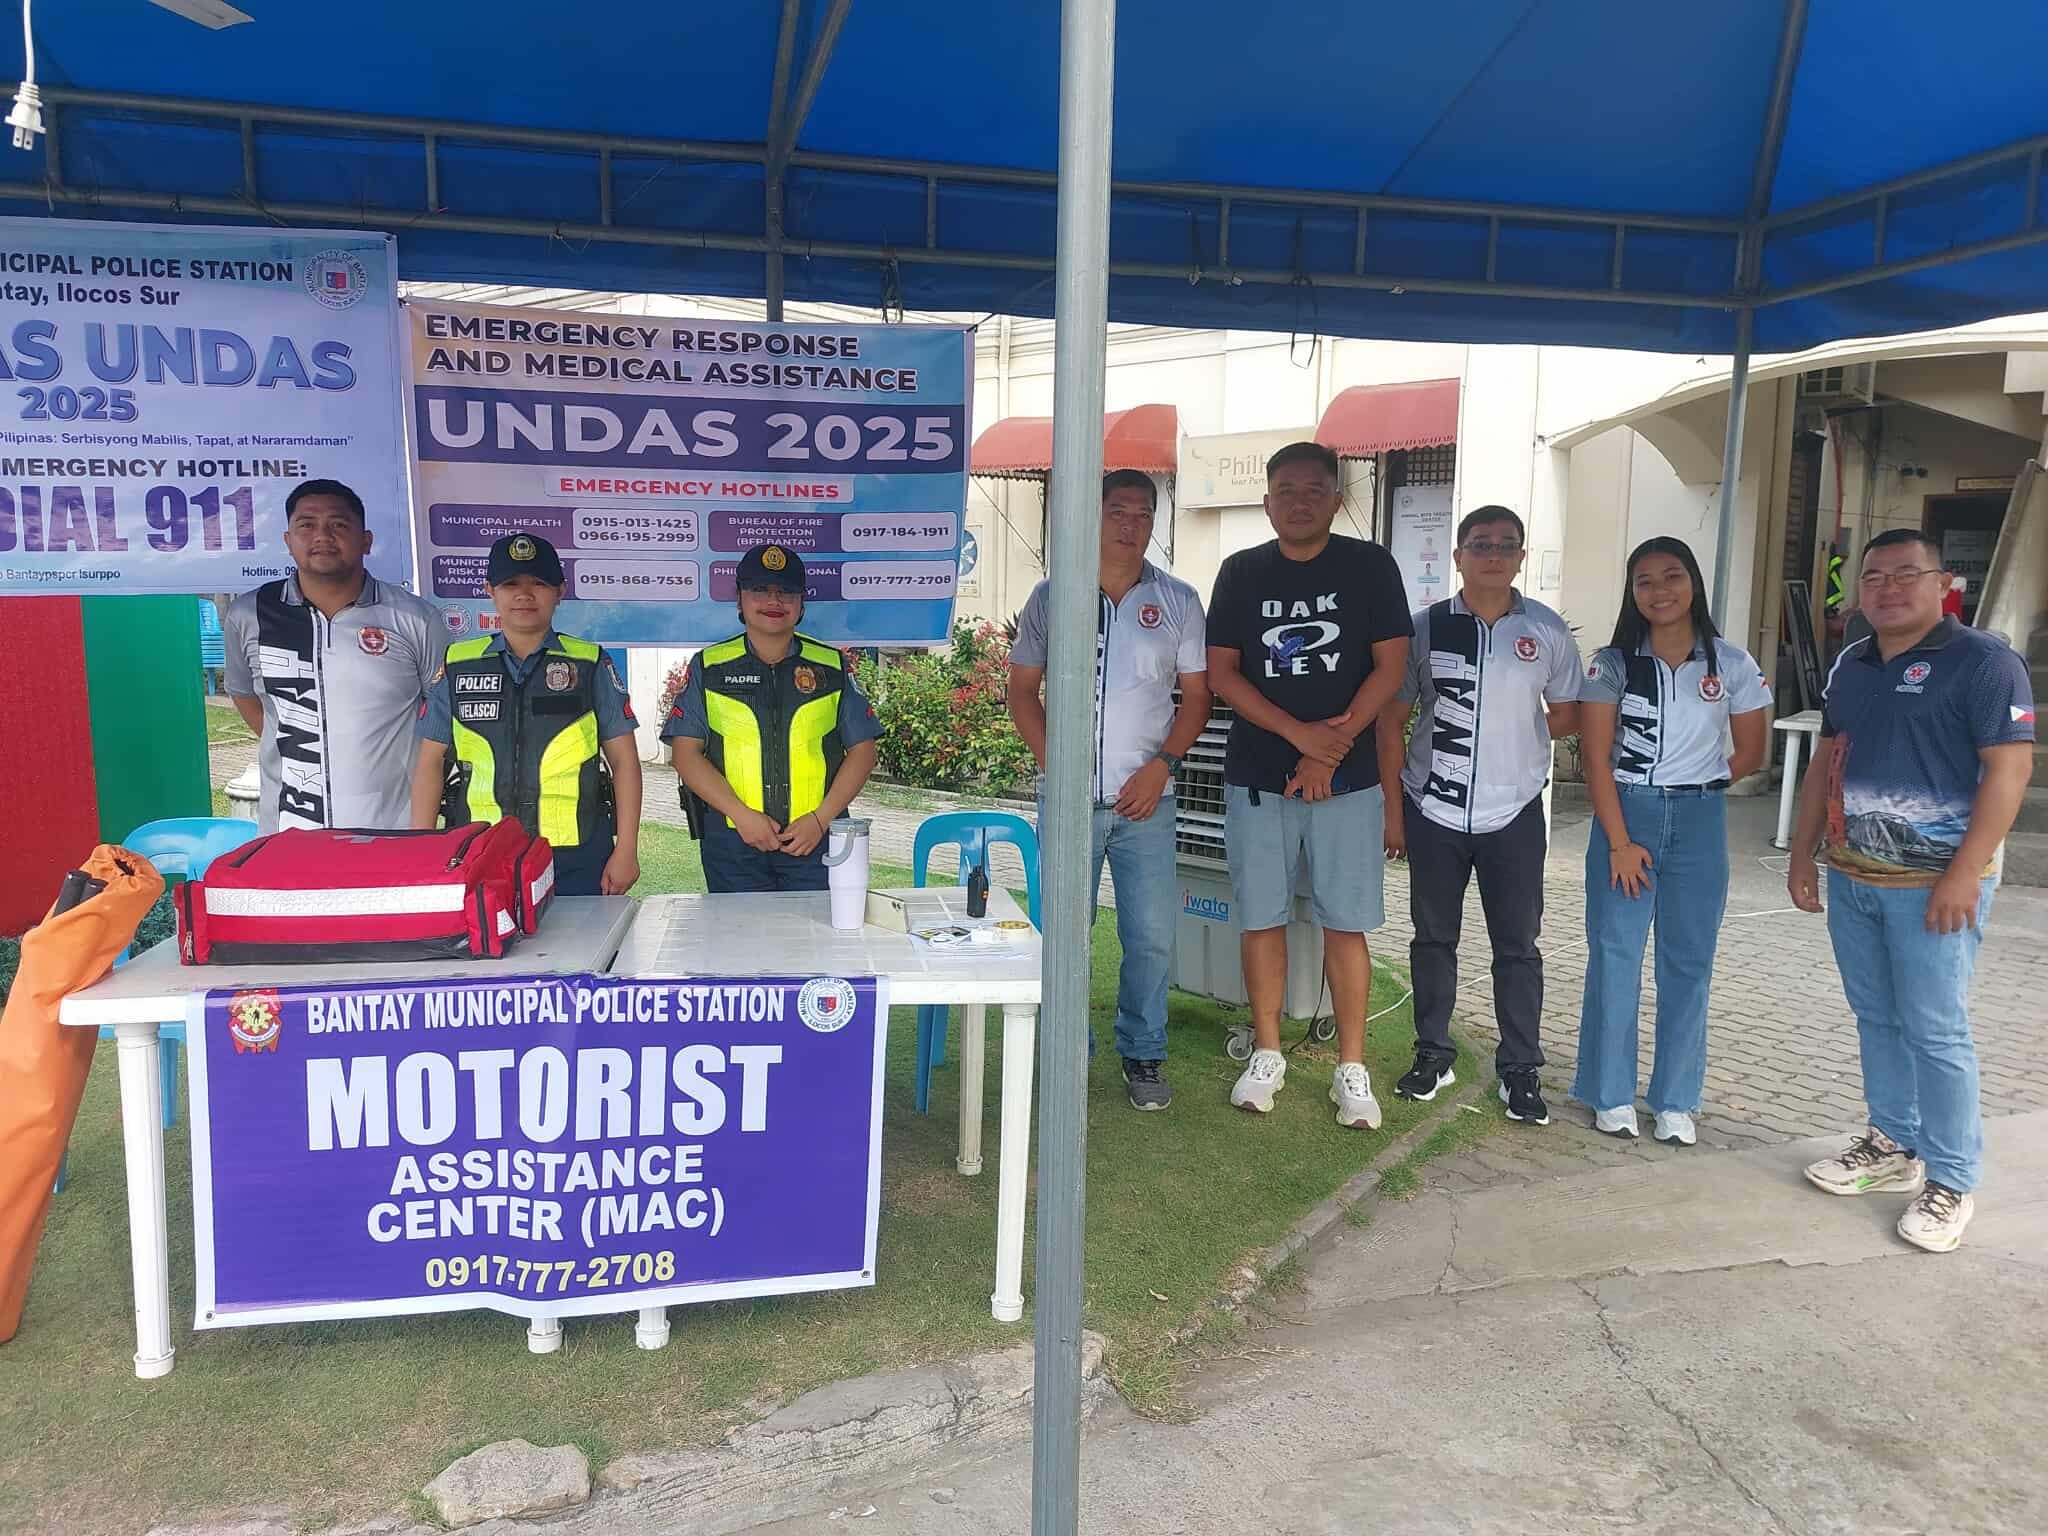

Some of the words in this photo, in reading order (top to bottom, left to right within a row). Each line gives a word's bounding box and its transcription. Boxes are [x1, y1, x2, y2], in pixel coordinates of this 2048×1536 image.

[91, 255, 182, 279] POLICE
[190, 260, 293, 282] STATION
[58, 282, 132, 304] Ilocos
[140, 285, 180, 306] Sur
[426, 314, 660, 349] EMERGENCY
[672, 329, 859, 359] RESPONSE
[84, 322, 357, 392] UNDAS
[426, 348, 512, 374] AND
[524, 352, 692, 384] MEDICAL
[703, 361, 917, 392] ASSISTANCE
[17, 385, 139, 422] 2025
[62, 432, 138, 447] Serbisyong
[142, 434, 192, 447] Mabilis,
[196, 434, 234, 448] Tapat,
[237, 436, 249, 446] at
[428, 398, 740, 458] UNDAS
[766, 411, 955, 463] 2025
[177, 459, 307, 478] HOTLINE:
[560, 477, 713, 497] EMERGENCY
[722, 481, 840, 499] HOTLINES
[145, 486, 256, 552] 911
[441, 516, 510, 526] MUNICIPAL
[513, 518, 562, 527] HEALTH
[582, 516, 692, 529] 0915-013-1425
[728, 517, 777, 526] BUREAU
[798, 518, 824, 526] FIRE
[579, 531, 696, 543] 0966-195-2999
[739, 527, 813, 537] PROTECTION
[852, 526, 950, 538] 0917-184-1911
[242, 566, 282, 577] Hotline:
[439, 558, 490, 567] MUNICIP
[448, 568, 475, 576] RISK
[579, 574, 694, 586] 0915-868-7536
[849, 574, 952, 586] 0917-777-2708
[1262, 592, 1338, 618] OAK
[1265, 652, 1341, 678] LEY
[458, 675, 499, 691] POLICE
[724, 675, 761, 684] PADRE
[460, 702, 497, 719] VELASCO
[307, 993, 416, 1034] BANTAY
[424, 987, 569, 1029] MUNICIPAL
[575, 987, 669, 1024] POLICE
[676, 987, 785, 1023] STATION
[305, 1045, 783, 1151] MOTORIST
[390, 1144, 704, 1196] ASSISTANCE
[367, 1195, 564, 1243] CENTER
[580, 1187, 725, 1249] (MAC)
[425, 1250, 676, 1293] 0917-777-2708
